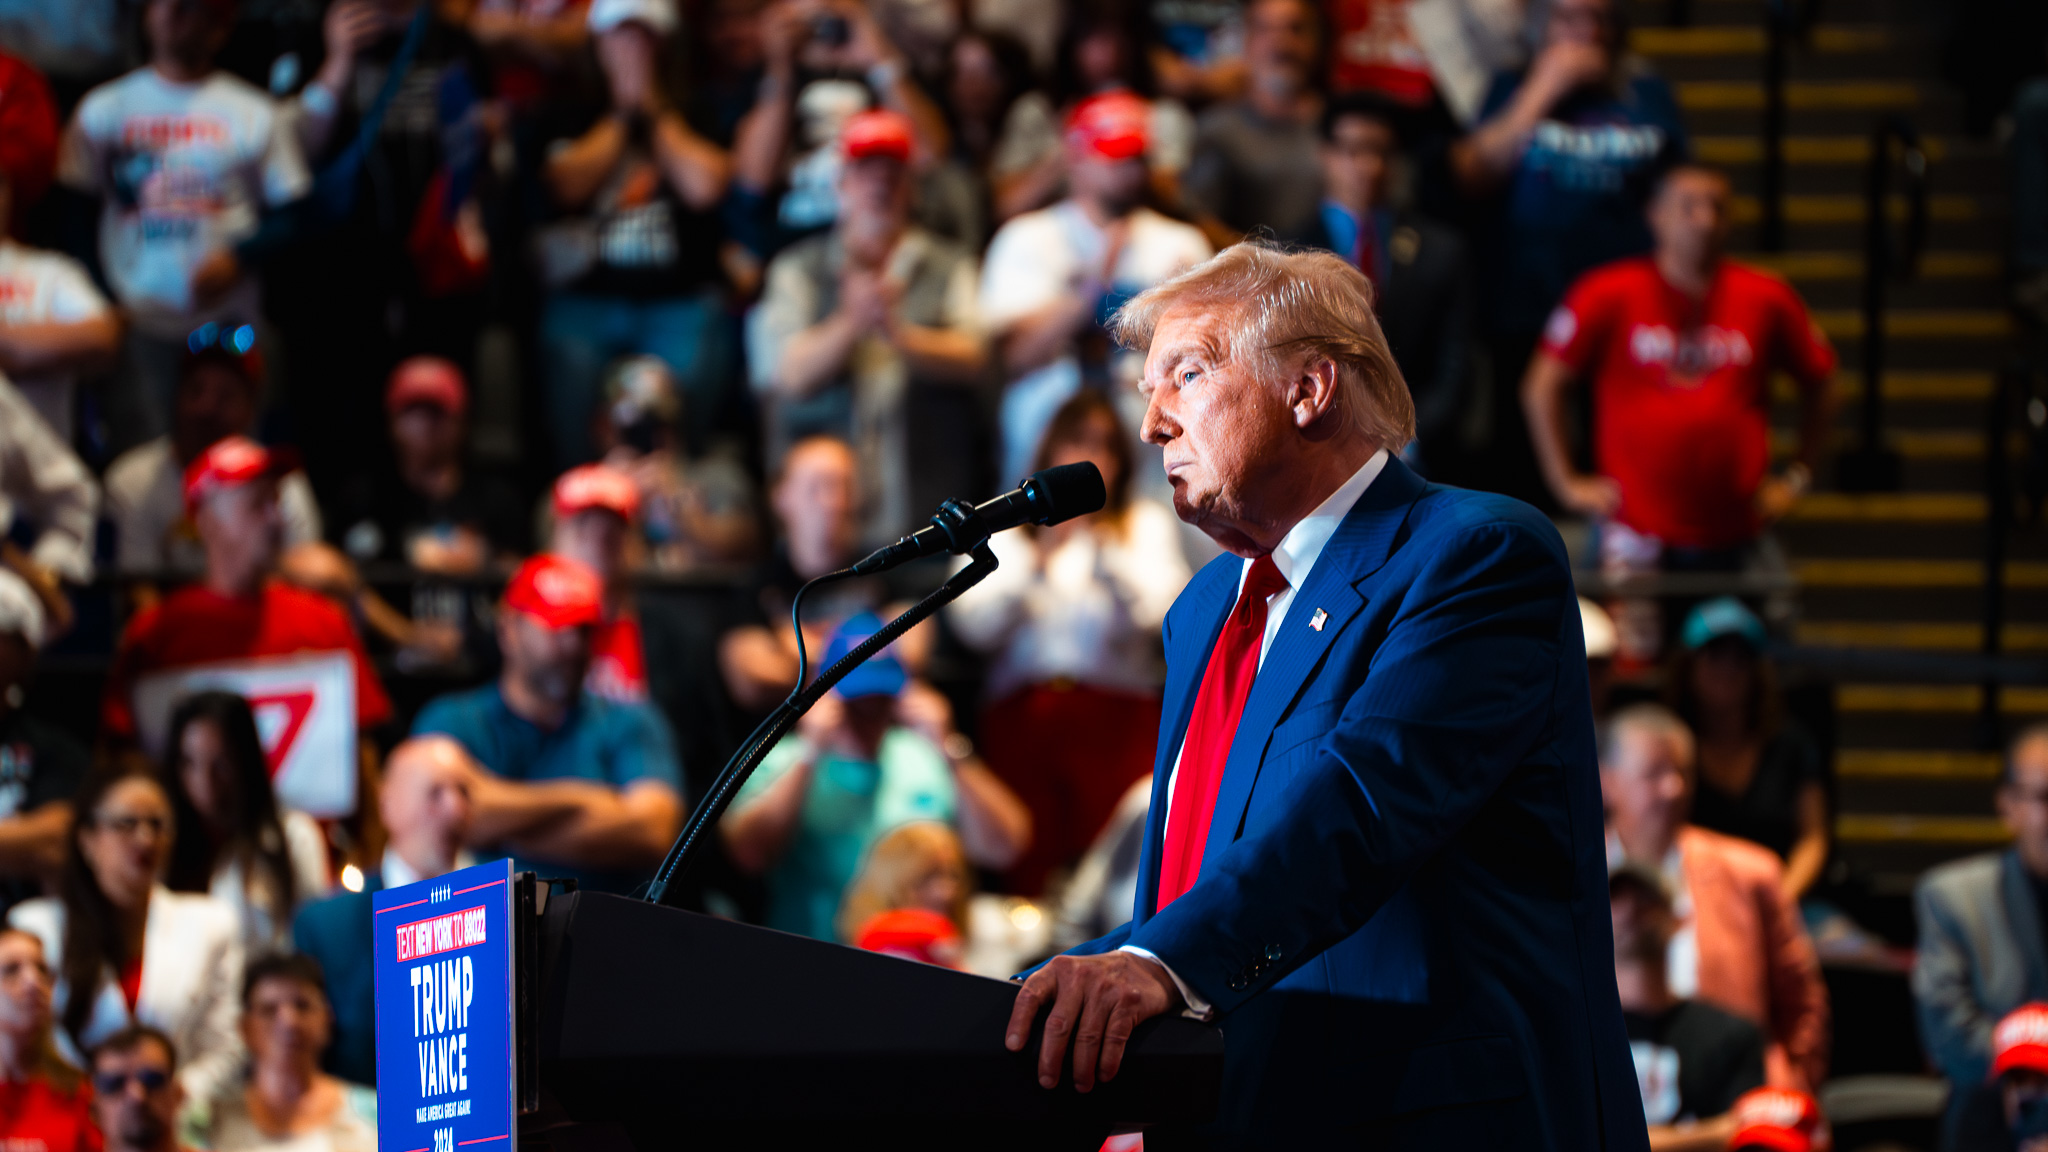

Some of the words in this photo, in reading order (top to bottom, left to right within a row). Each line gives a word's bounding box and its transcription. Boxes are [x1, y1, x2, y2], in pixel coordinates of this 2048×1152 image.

[396, 925, 415, 960] TEXT
[415, 921, 433, 957] NEW
[433, 916, 454, 952] YORK
[453, 913, 464, 947] TO
[464, 907, 486, 945] 88022
[410, 955, 474, 1037] TRUMP
[418, 1033, 468, 1098] VANCE
[416, 1107, 427, 1124] MAKE
[427, 1104, 444, 1121] AMERICA
[444, 1101, 457, 1119] GREAT
[434, 1126, 453, 1152] 2024
